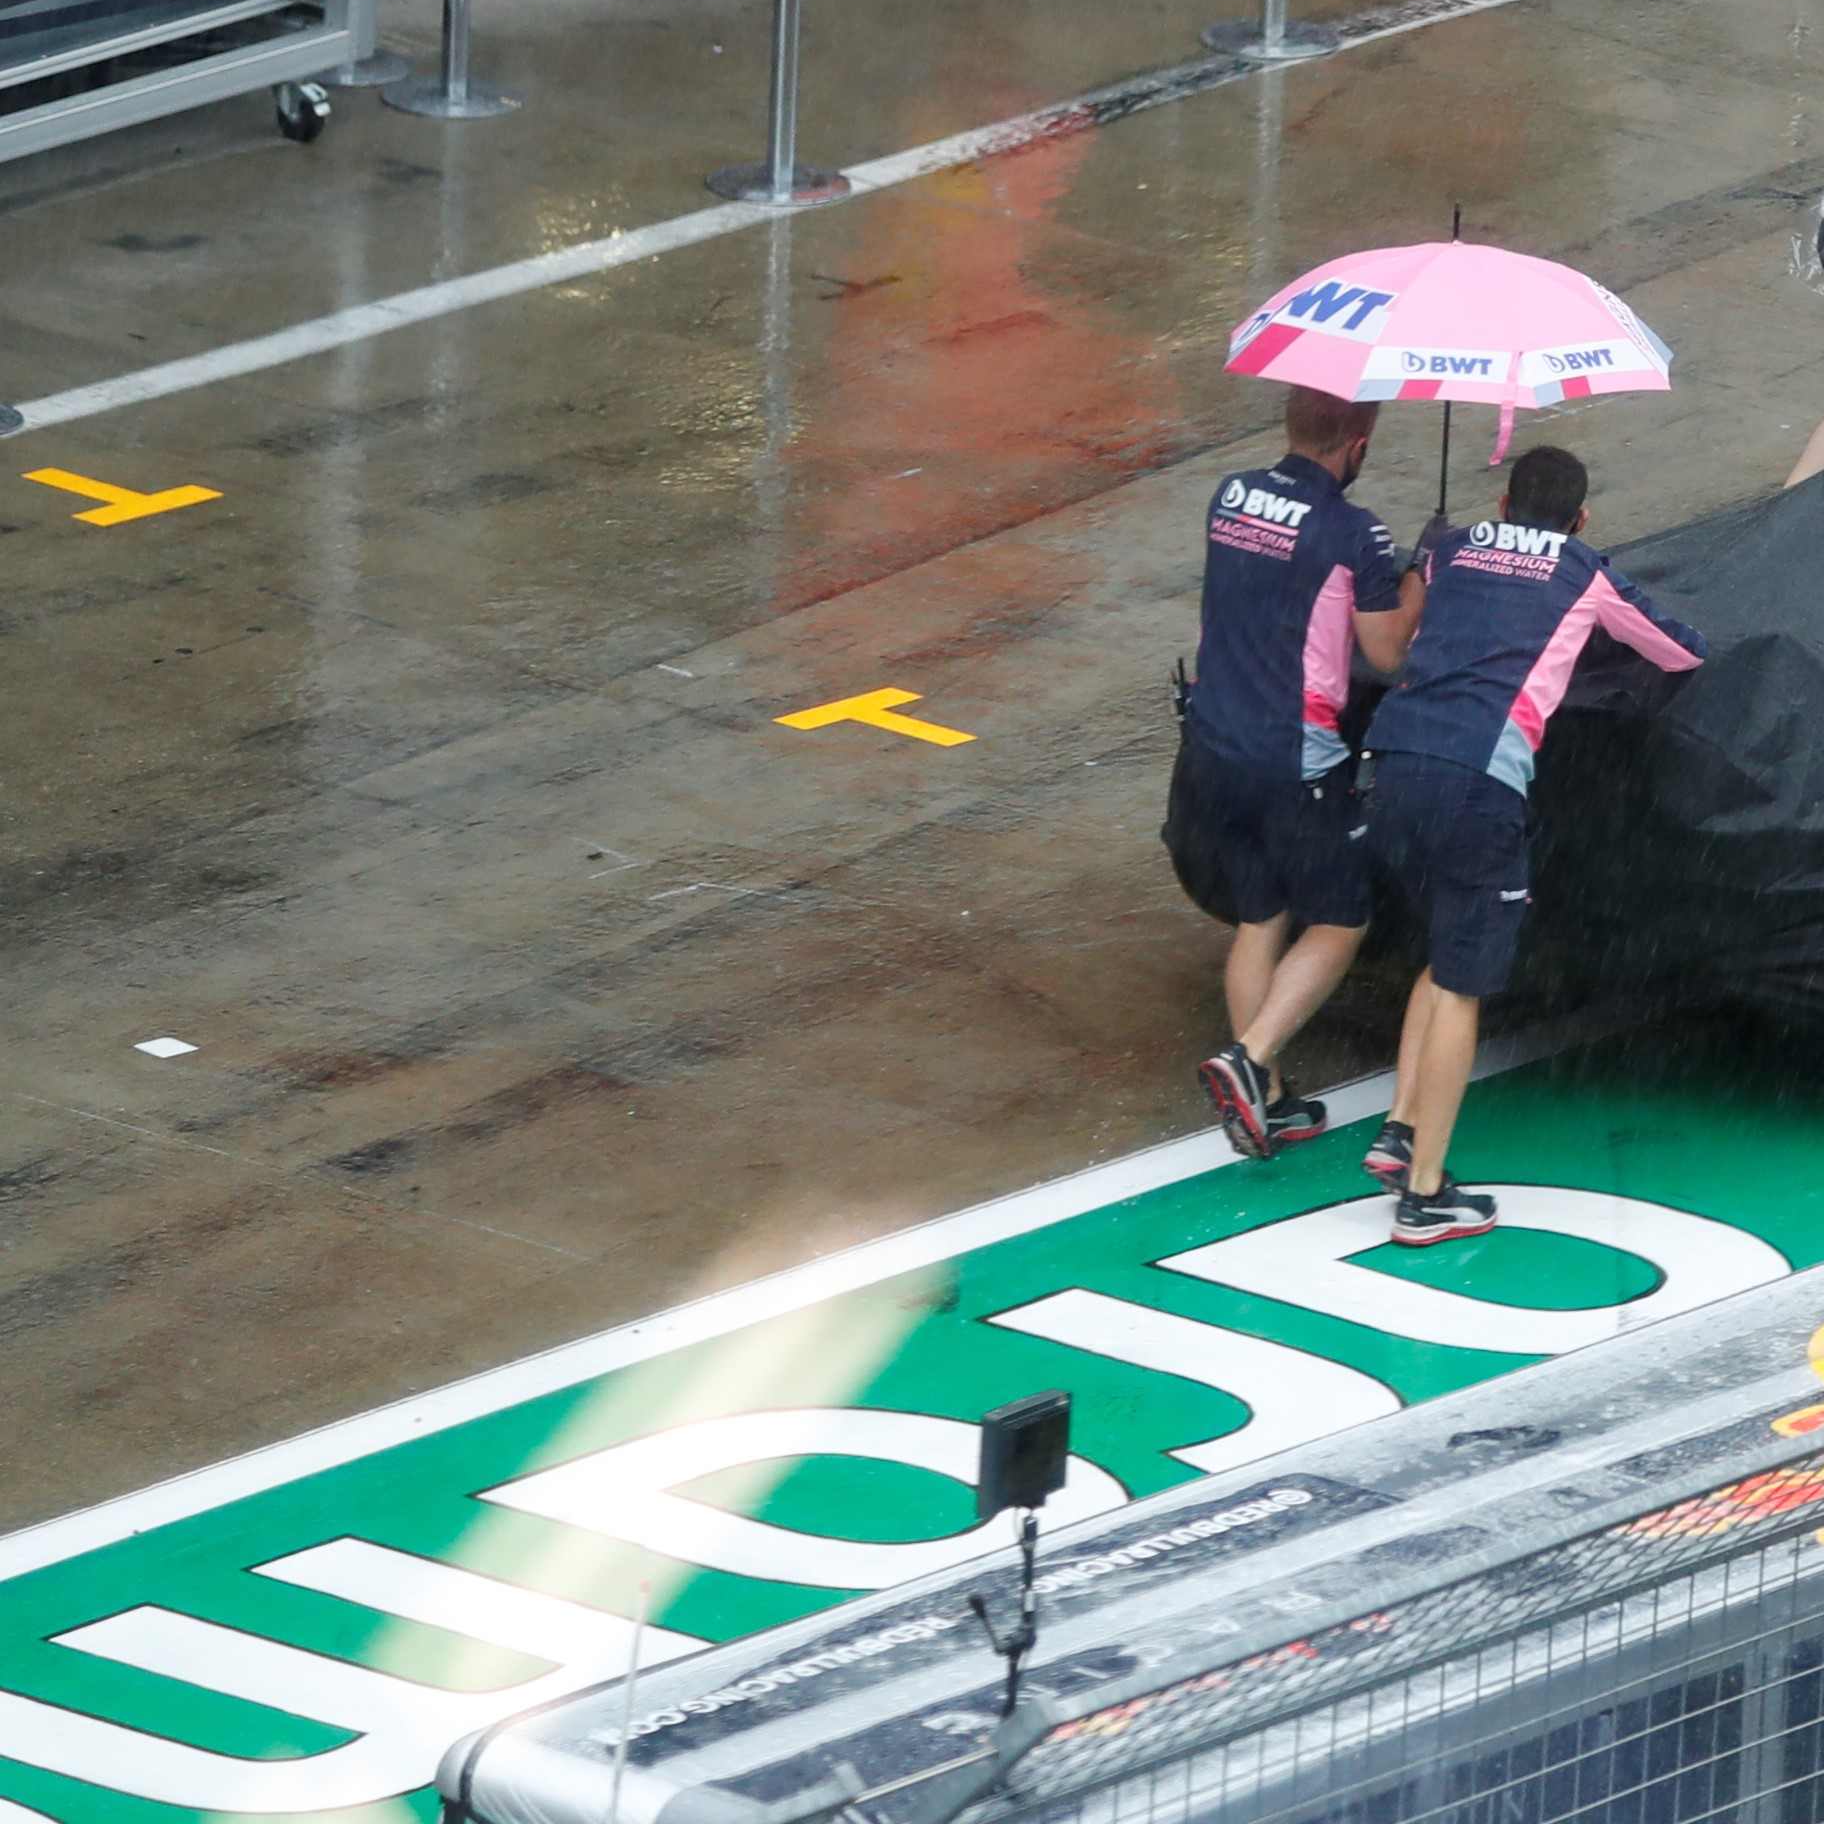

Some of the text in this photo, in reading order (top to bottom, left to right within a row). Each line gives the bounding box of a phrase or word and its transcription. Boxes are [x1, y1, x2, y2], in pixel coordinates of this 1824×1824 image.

[1287, 281, 1396, 331] WT
[1429, 355, 1492, 376] BWT
[1562, 348, 1614, 370] BWT
[1242, 489, 1312, 527] BWT
[1211, 517, 1297, 553] MAGNESIUM
[1494, 523, 1568, 557] BWT
[1455, 549, 1557, 574] MAGNESIUM
